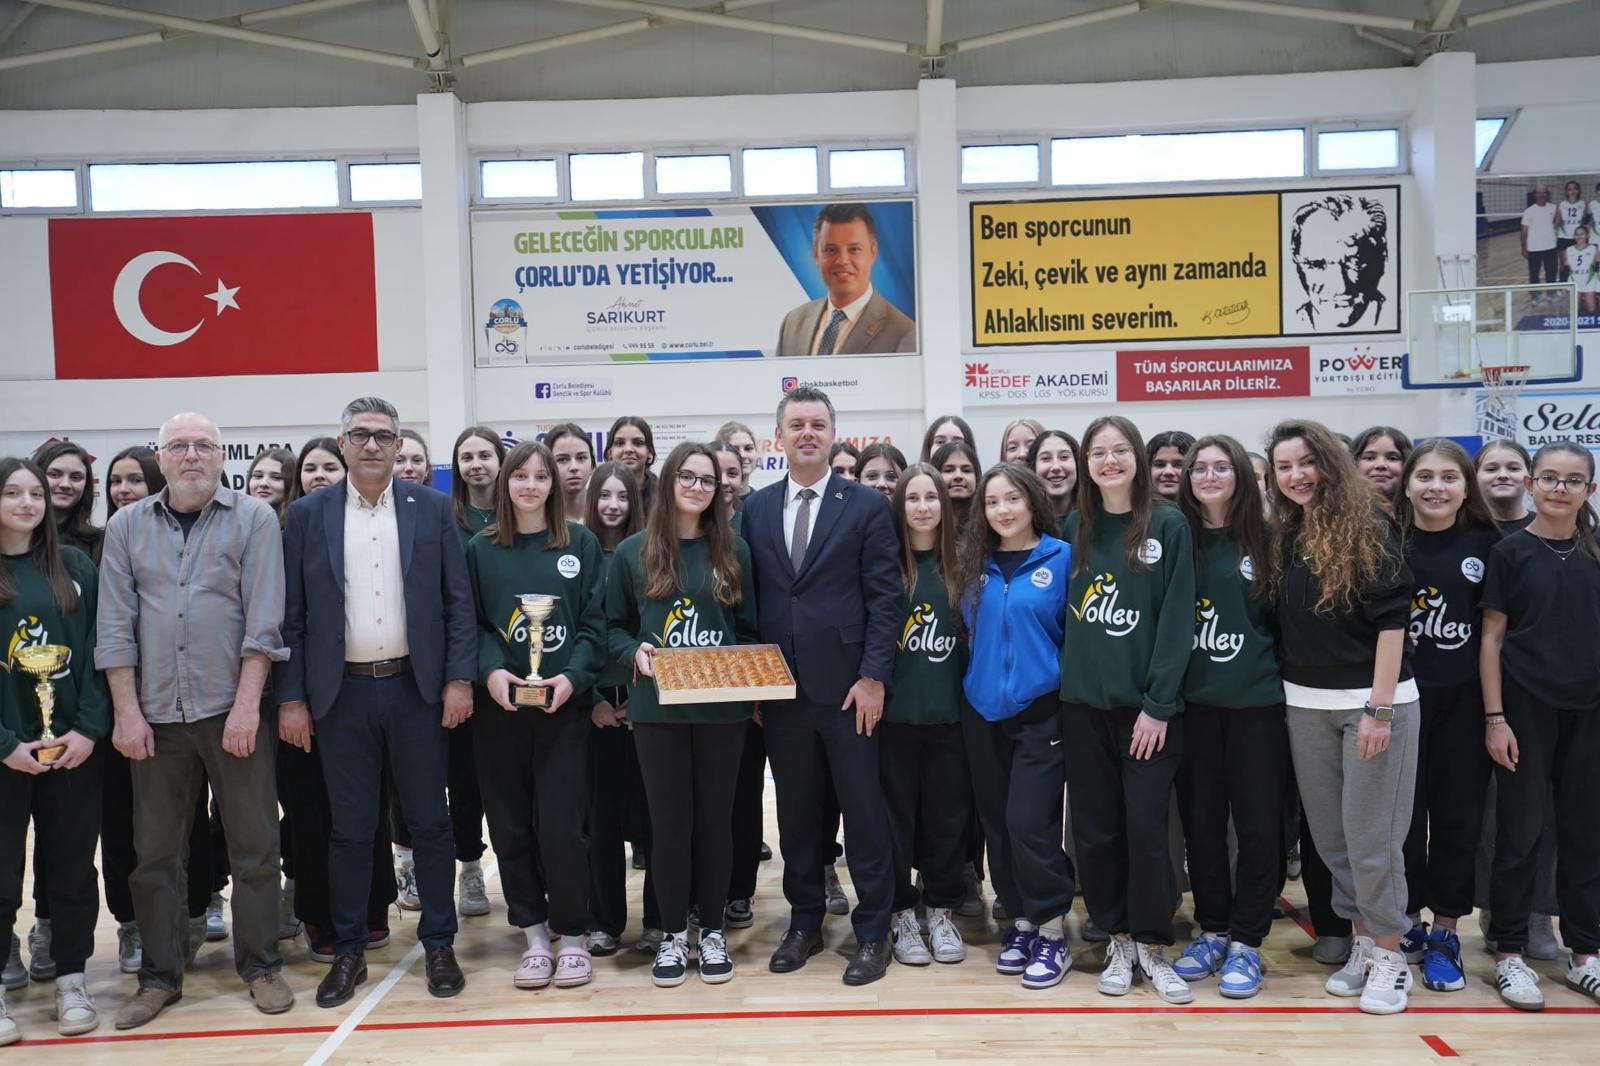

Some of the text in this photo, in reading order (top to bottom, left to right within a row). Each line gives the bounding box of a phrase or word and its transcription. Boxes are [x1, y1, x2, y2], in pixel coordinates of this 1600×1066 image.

[1567, 207, 1577, 217] 12
[513, 225, 744, 253] GELECEĞİN SPORCULARI
[980, 214, 1131, 246] Ben sporcunun
[1576, 255, 1583, 266] 5
[515, 257, 733, 293] ÇORLU'DA YETİŞİYOR...
[982, 252, 1267, 291] Zeki, çevik ve aynı zamanda
[586, 310, 666, 324] SARIKURT
[984, 303, 1178, 334] Ahlaklısını severim.
[1134, 358, 1293, 374] TÜM SPORCULARIMIZA
[1320, 355, 1402, 372] POWER
[979, 371, 1108, 388] HEDEF AKADEMİ
[1146, 376, 1281, 395] BAŞARILAR DİLERİZ.
[1315, 371, 1402, 383] YURTDIŞI EĞİTİ
[979, 388, 1109, 399] KPSS DGS LGS YÖS KURSU
[1069, 586, 1141, 637] Volley
[897, 612, 957, 663] Volley
